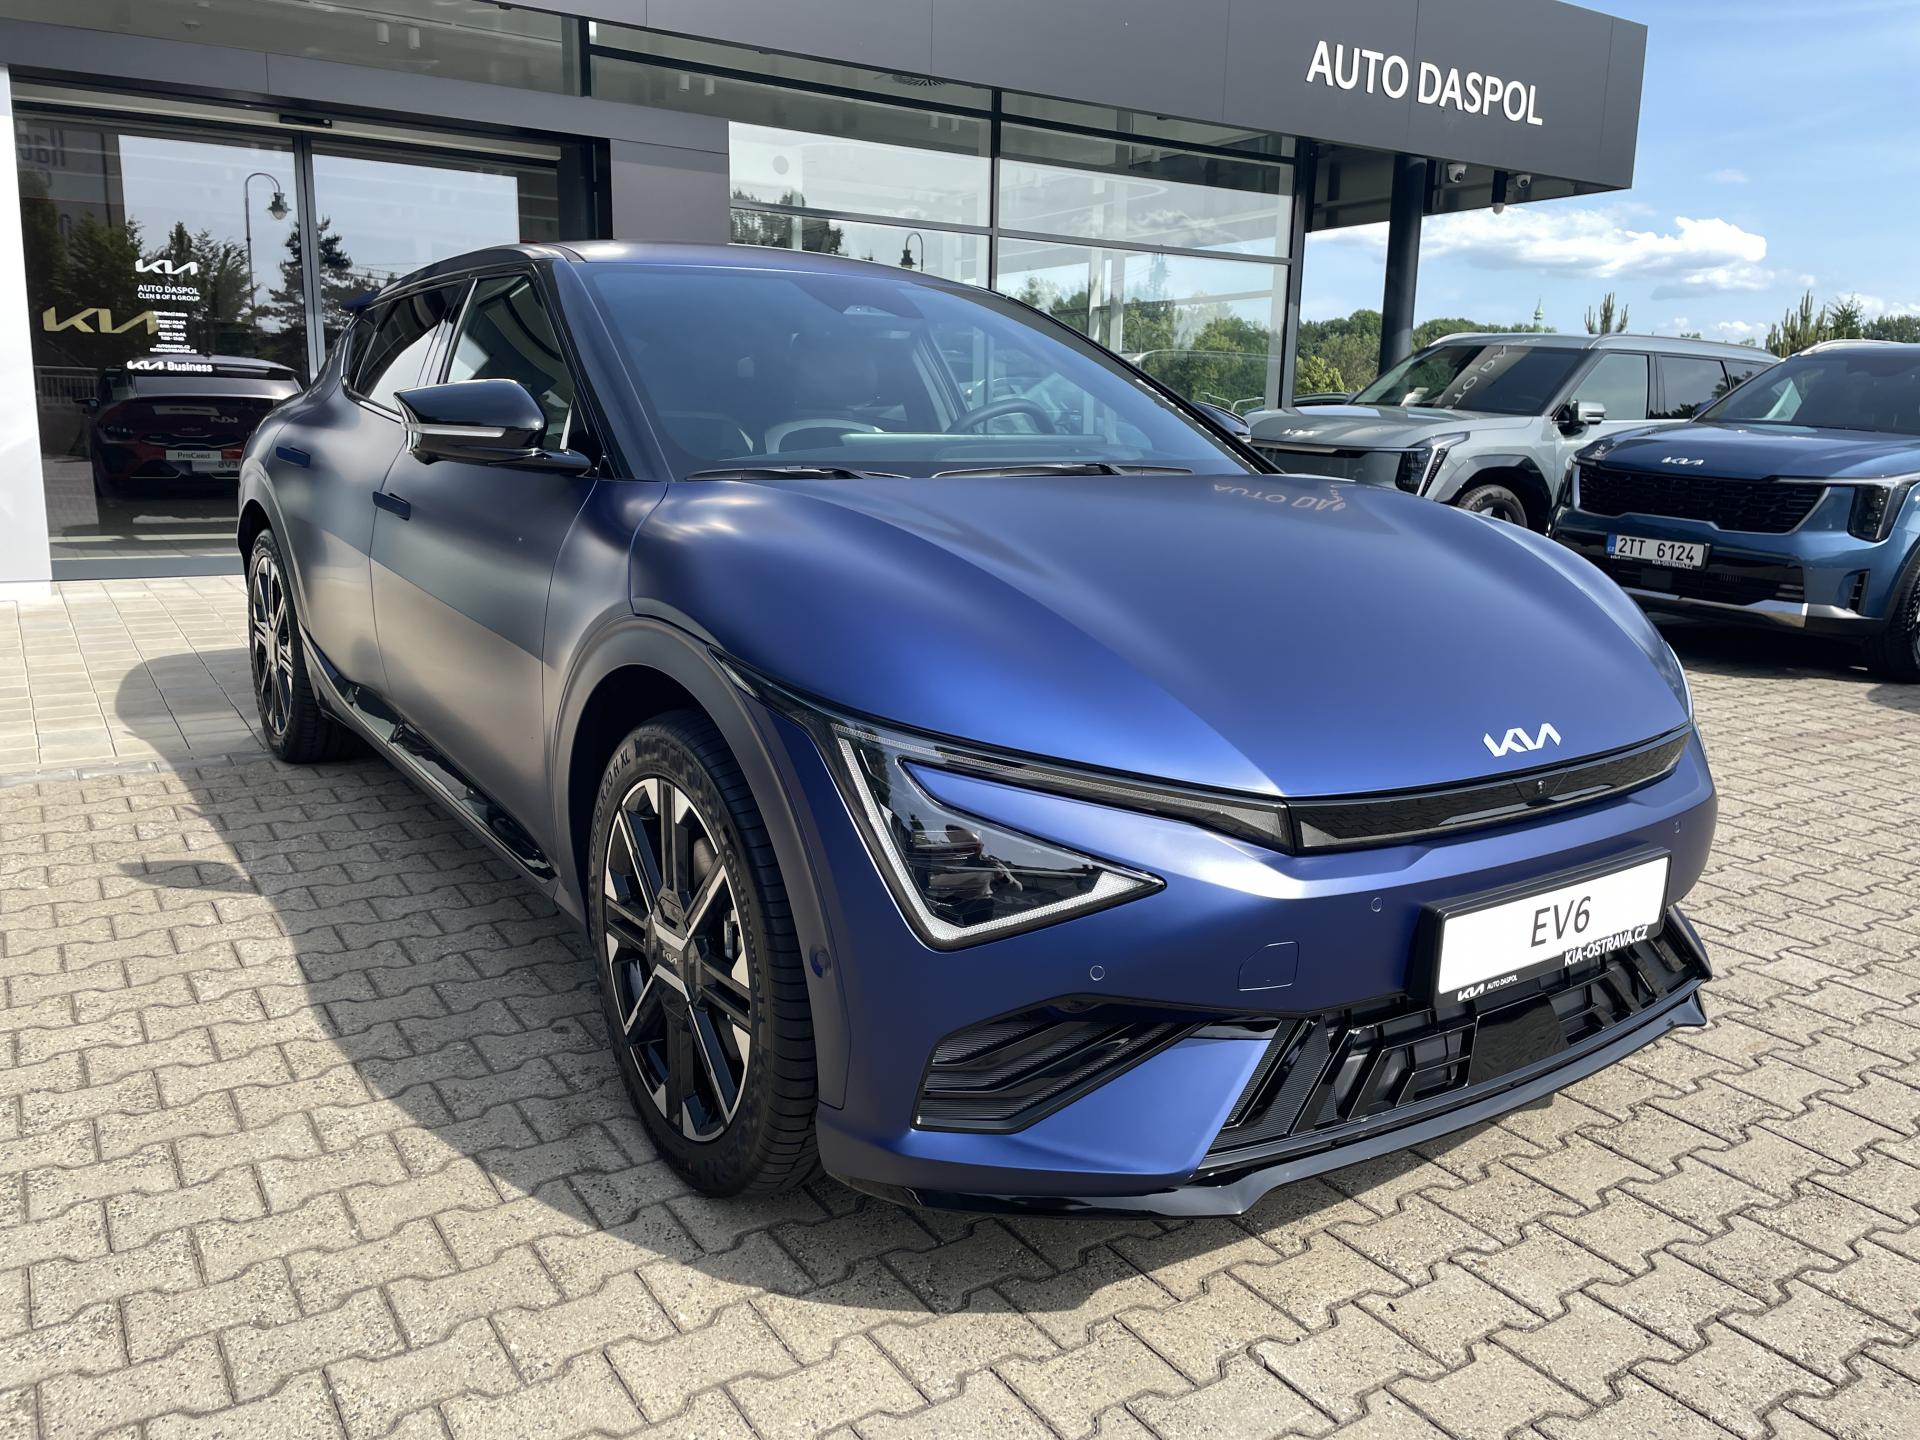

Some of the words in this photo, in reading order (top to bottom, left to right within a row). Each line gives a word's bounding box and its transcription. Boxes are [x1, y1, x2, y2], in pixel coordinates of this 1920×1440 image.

[1305, 40, 1409, 99] AUTO
[1417, 61, 1543, 126] DASPOL
[135, 259, 198, 276] KIA
[137, 284, 163, 293] AUTO
[165, 286, 200, 295] DASPOL
[42, 306, 159, 335] KIA
[126, 360, 164, 370] KIA
[167, 361, 213, 372] Business
[1661, 456, 1704, 466] KIA
[1618, 537, 1646, 556] 2TT
[1656, 542, 1695, 563] 6124
[1483, 723, 1561, 757] KIA
[620, 747, 631, 768] XL
[1530, 896, 1591, 947] EV6
[1564, 925, 1648, 967] KIA-OSTRAVA.CZ
[1457, 983, 1485, 1001] KIA
[1486, 980, 1500, 990] AUTO
[1500, 974, 1518, 985] DASPOL
